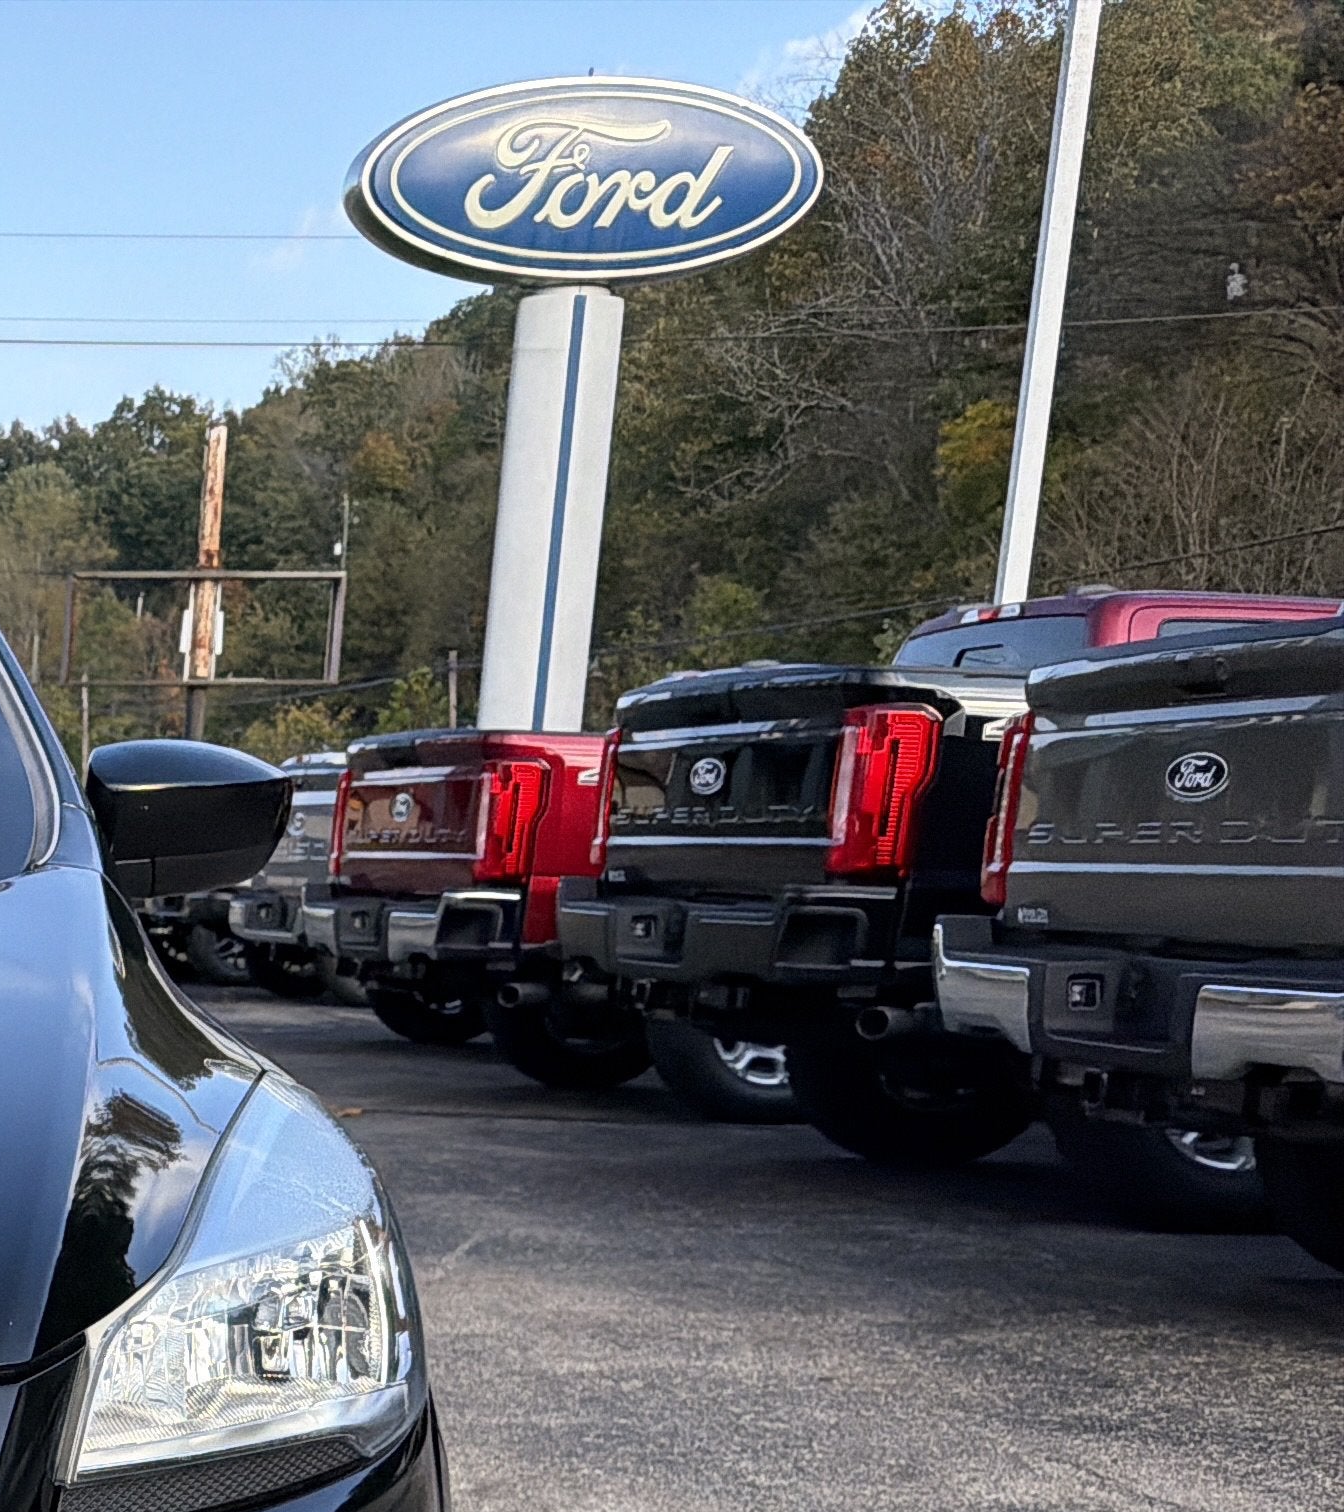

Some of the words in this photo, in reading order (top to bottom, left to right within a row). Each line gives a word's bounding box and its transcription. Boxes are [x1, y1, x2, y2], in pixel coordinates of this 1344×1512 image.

[464, 117, 735, 231] Ford
[1174, 758, 1218, 788] Ford
[1027, 821, 1203, 845] SUPER
[1219, 819, 1344, 845] DUT
